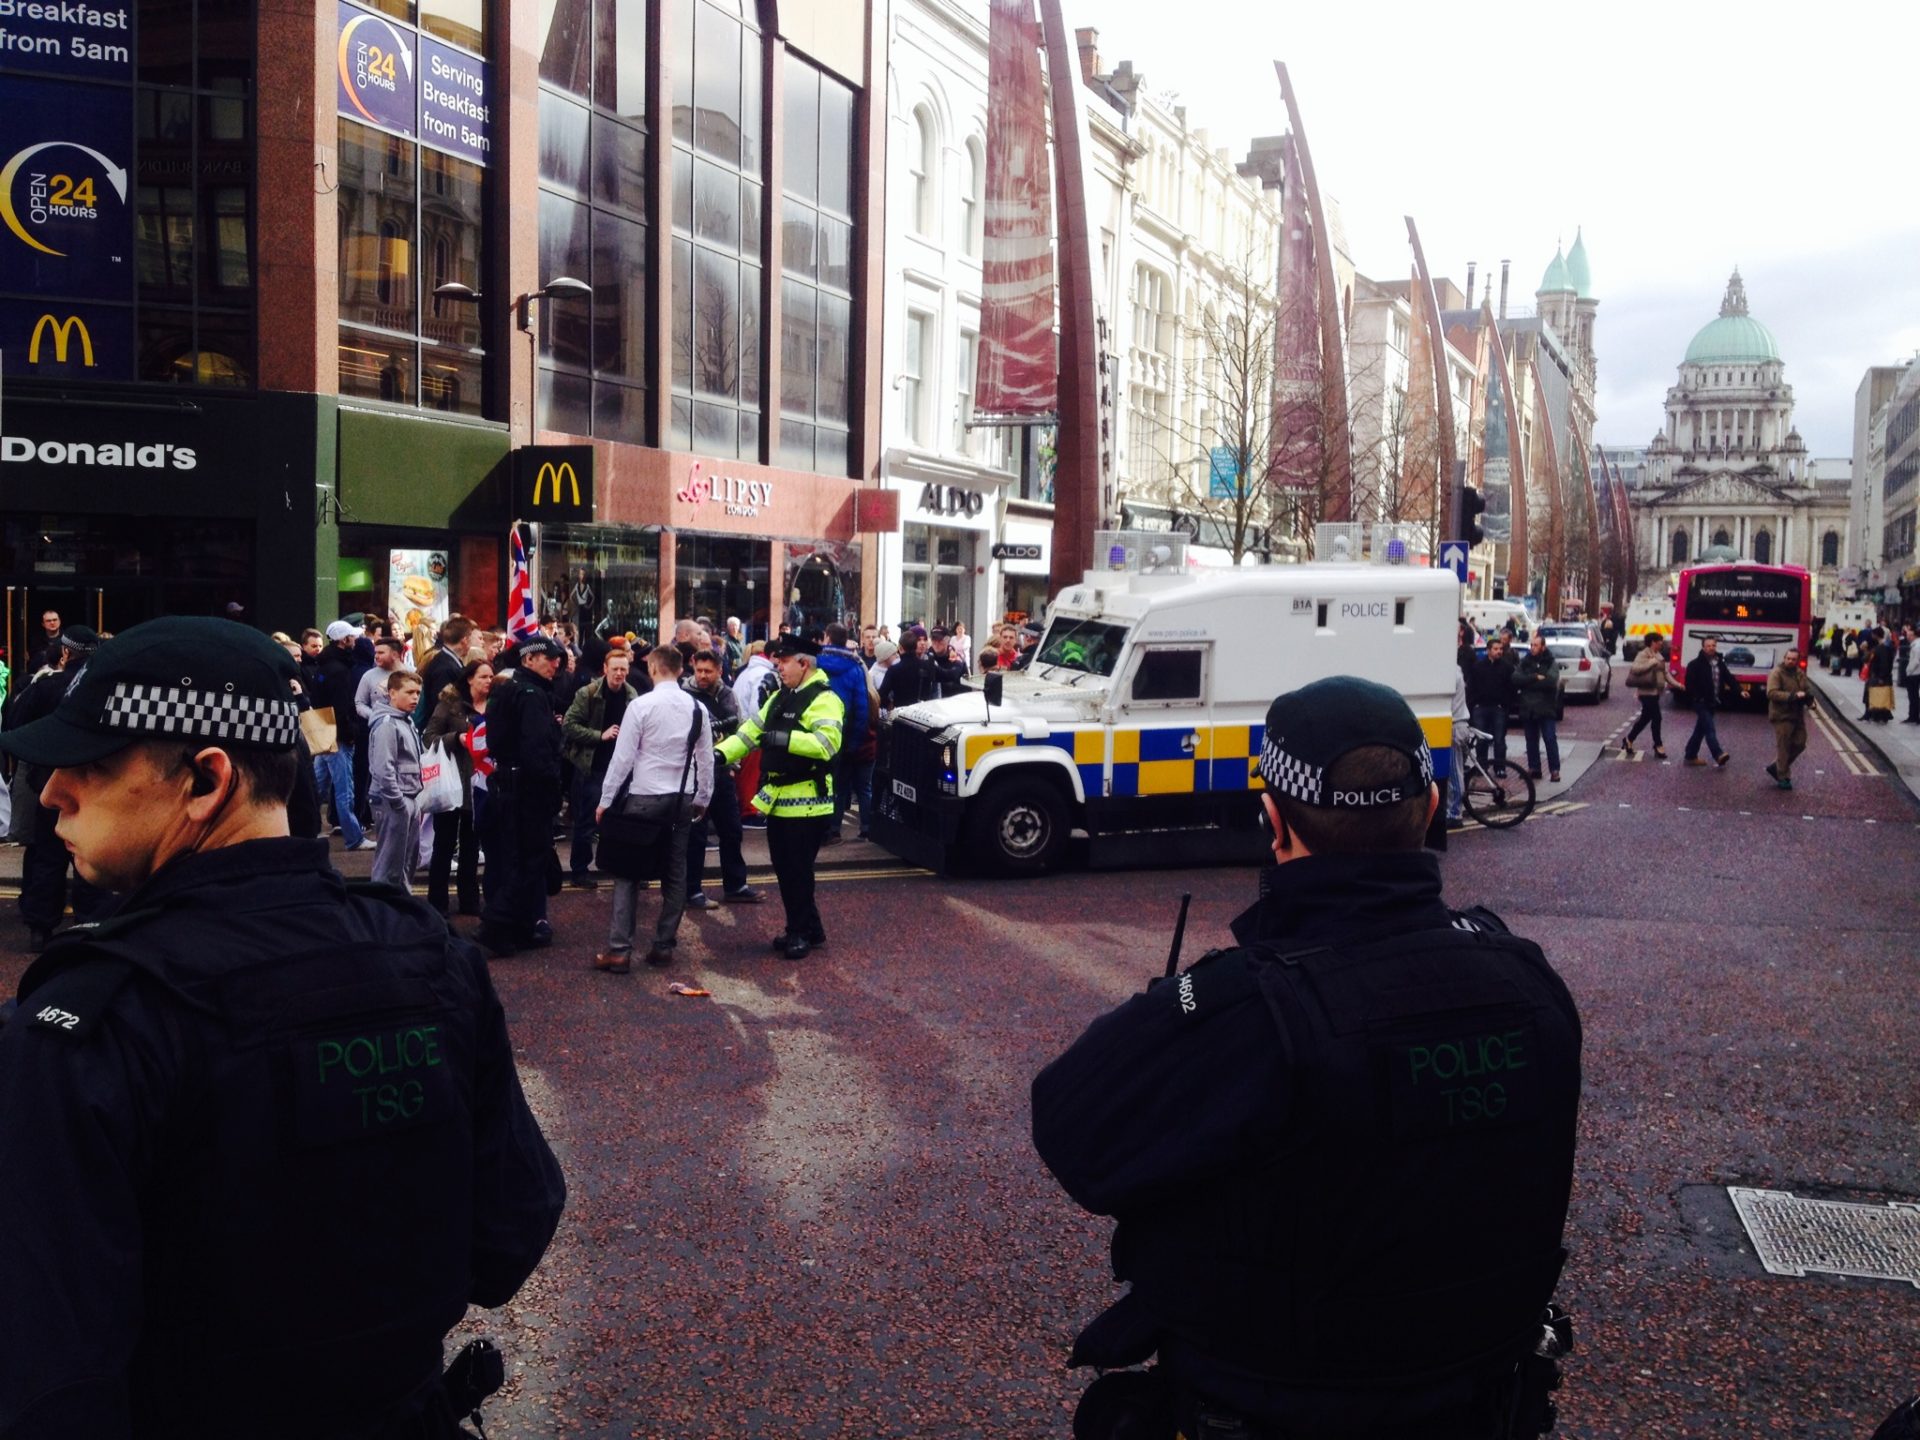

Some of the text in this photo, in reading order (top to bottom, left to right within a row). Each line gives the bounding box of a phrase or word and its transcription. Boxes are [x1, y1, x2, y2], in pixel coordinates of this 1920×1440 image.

[0, 0, 128, 30] Breakfast
[0, 28, 129, 63] from 5am
[356, 41, 368, 89] OPEN
[367, 46, 396, 80] 24
[431, 55, 484, 97] Serving
[367, 73, 396, 92] HOURS
[423, 80, 490, 124] Breakfast
[423, 111, 490, 152] from 5am
[30, 173, 47, 224] OPEN
[49, 174, 97, 208] 24
[49, 205, 98, 219] HOURS
[1, 436, 197, 470] Donald's
[709, 474, 772, 507] LIPSY
[917, 482, 984, 519] ALDO
[997, 545, 1040, 557] ALDO
[1341, 602, 1389, 617] POLICE
[1700, 588, 1787, 599] www.translink.co.uk
[1333, 787, 1401, 806] POLICE
[36, 1005, 80, 1030] 4672
[317, 1026, 442, 1084] POLICE
[1409, 1029, 1529, 1085] POLICE
[352, 1079, 424, 1129] TSG
[1439, 1081, 1507, 1127] TSG
